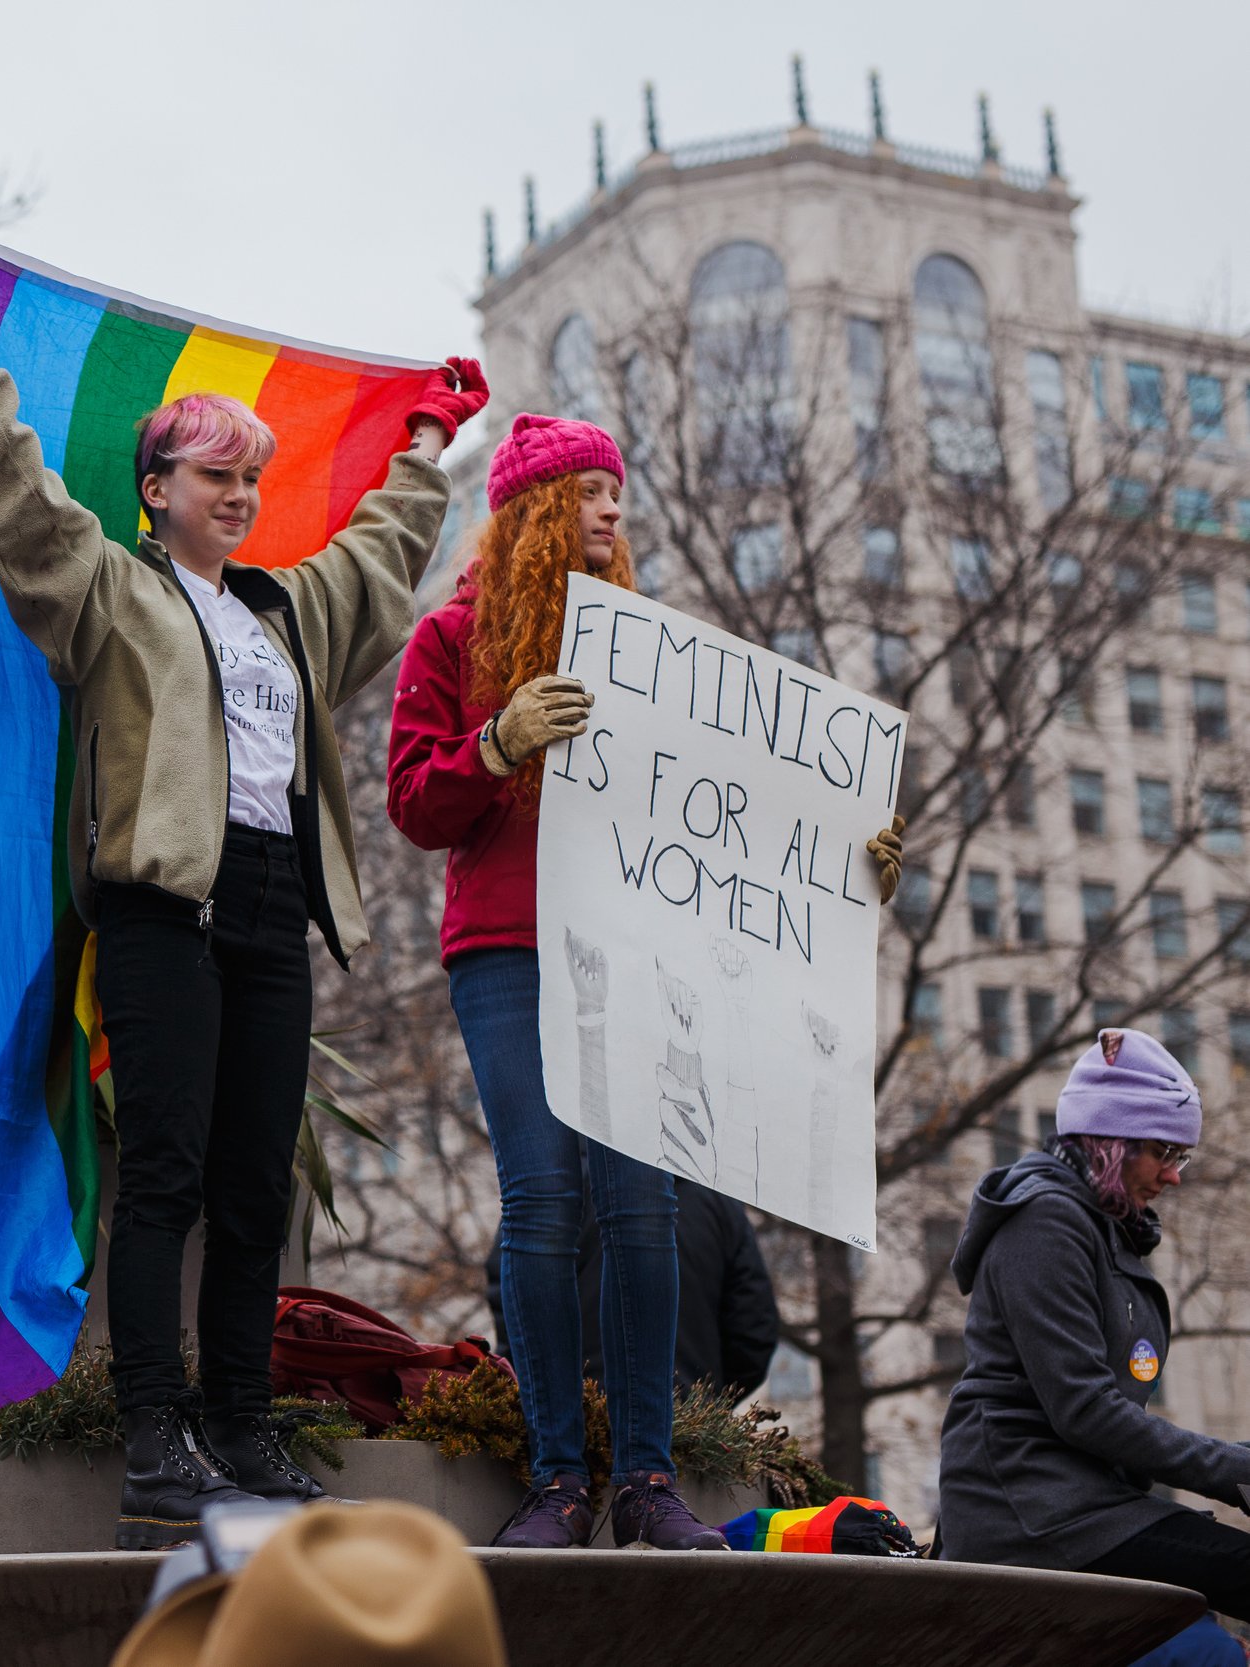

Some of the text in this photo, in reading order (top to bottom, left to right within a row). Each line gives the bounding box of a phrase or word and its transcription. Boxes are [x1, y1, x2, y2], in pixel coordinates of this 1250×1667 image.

[254, 684, 295, 715] Hist
[567, 603, 902, 808] FEMINISM
[552, 728, 867, 907] IS FOR ALL
[612, 821, 812, 965] WOMEN
